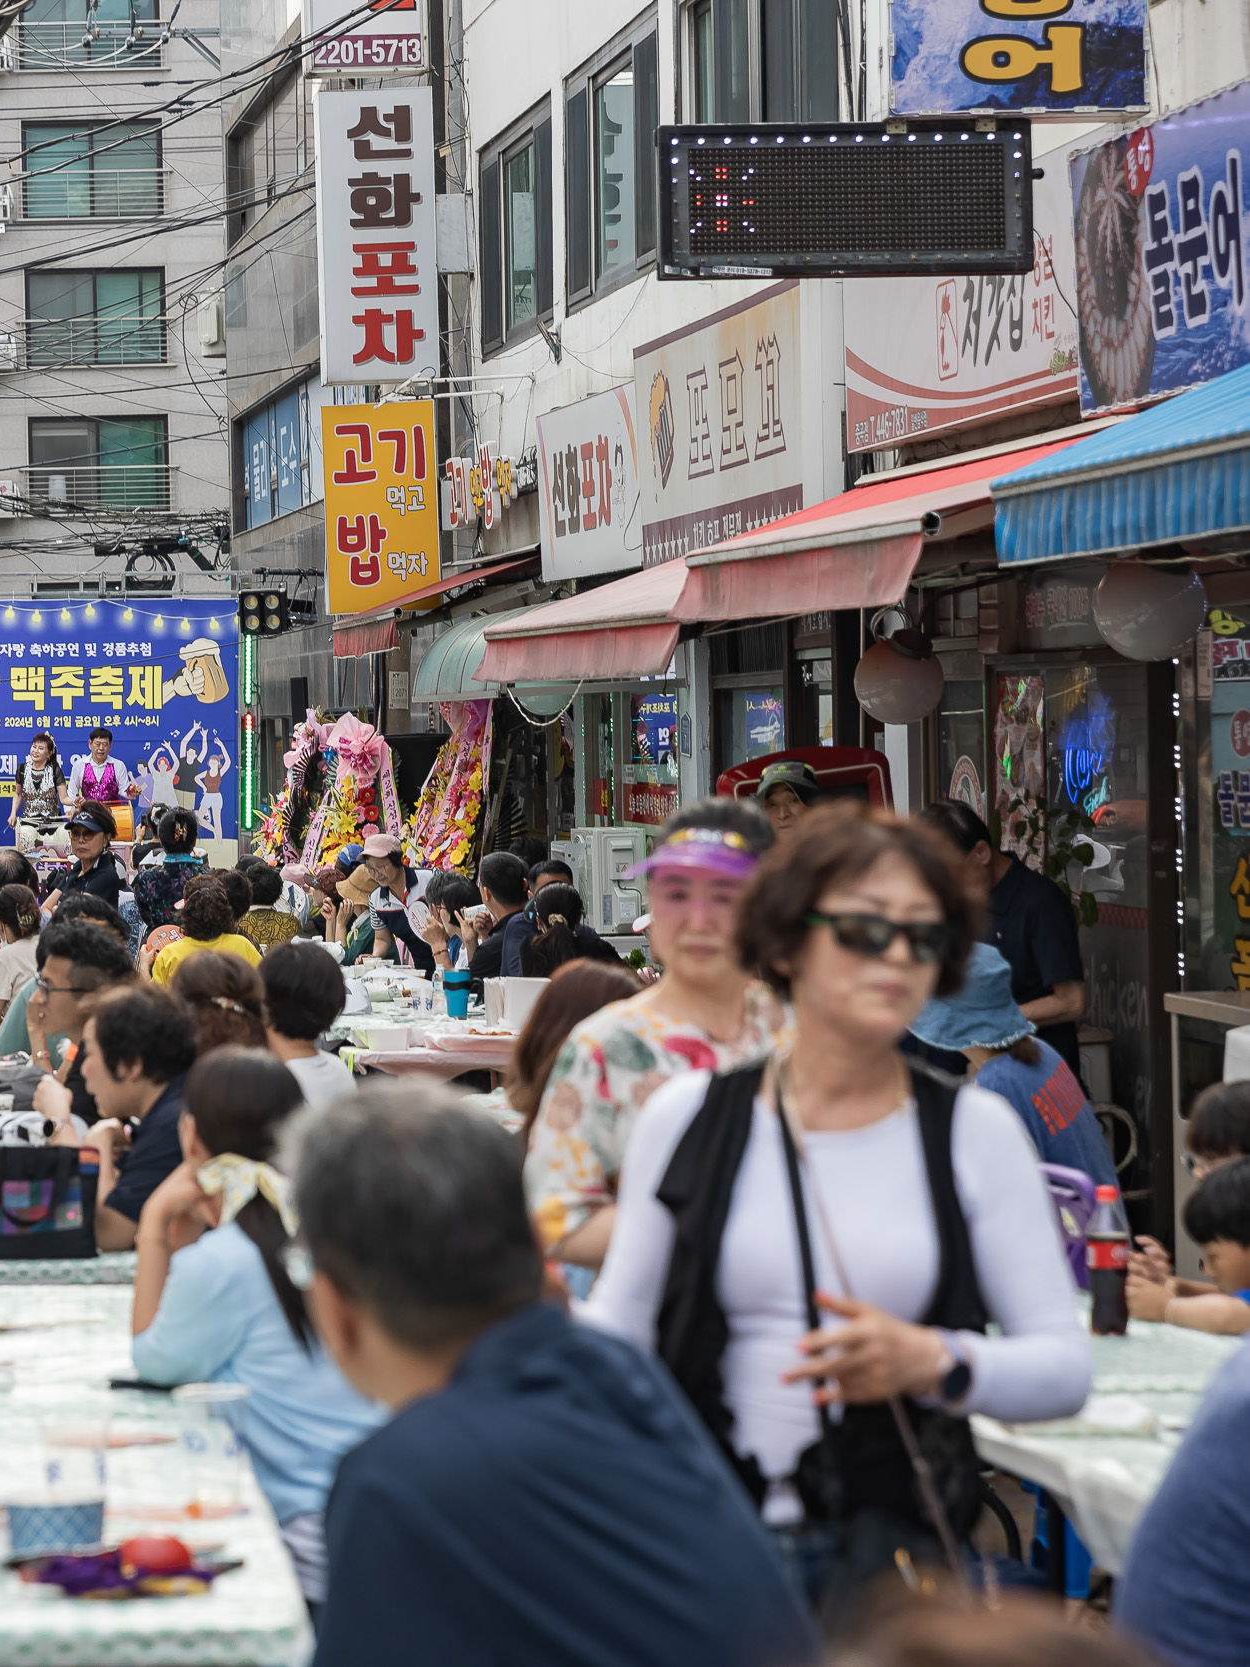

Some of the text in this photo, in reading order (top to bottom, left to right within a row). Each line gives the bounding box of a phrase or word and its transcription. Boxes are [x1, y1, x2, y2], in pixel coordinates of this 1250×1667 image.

[314, 38, 421, 64] 2201-5713
[346, 104, 425, 366] 선화포차
[1032, 293, 1055, 342] 치킨
[870, 404, 909, 444] T.446-7831
[332, 423, 427, 486] 고기
[386, 485, 426, 517] 먹고
[480, 443, 495, 530] 밥
[552, 434, 612, 538] 선화포차
[337, 514, 389, 588] 밥
[387, 551, 429, 582] 먹자
[29, 642, 80, 658] 축하공연
[85, 642, 97, 657] 및
[102, 641, 152, 657] 경품추첨
[10, 664, 163, 712] 맥주축제
[4, 715, 33, 728] 2024년
[36, 715, 51, 728] 6월
[54, 715, 72, 728] 21일
[75, 715, 101, 728] 금요일
[104, 715, 121, 727] 오후
[124, 714, 160, 728] 4시~8시
